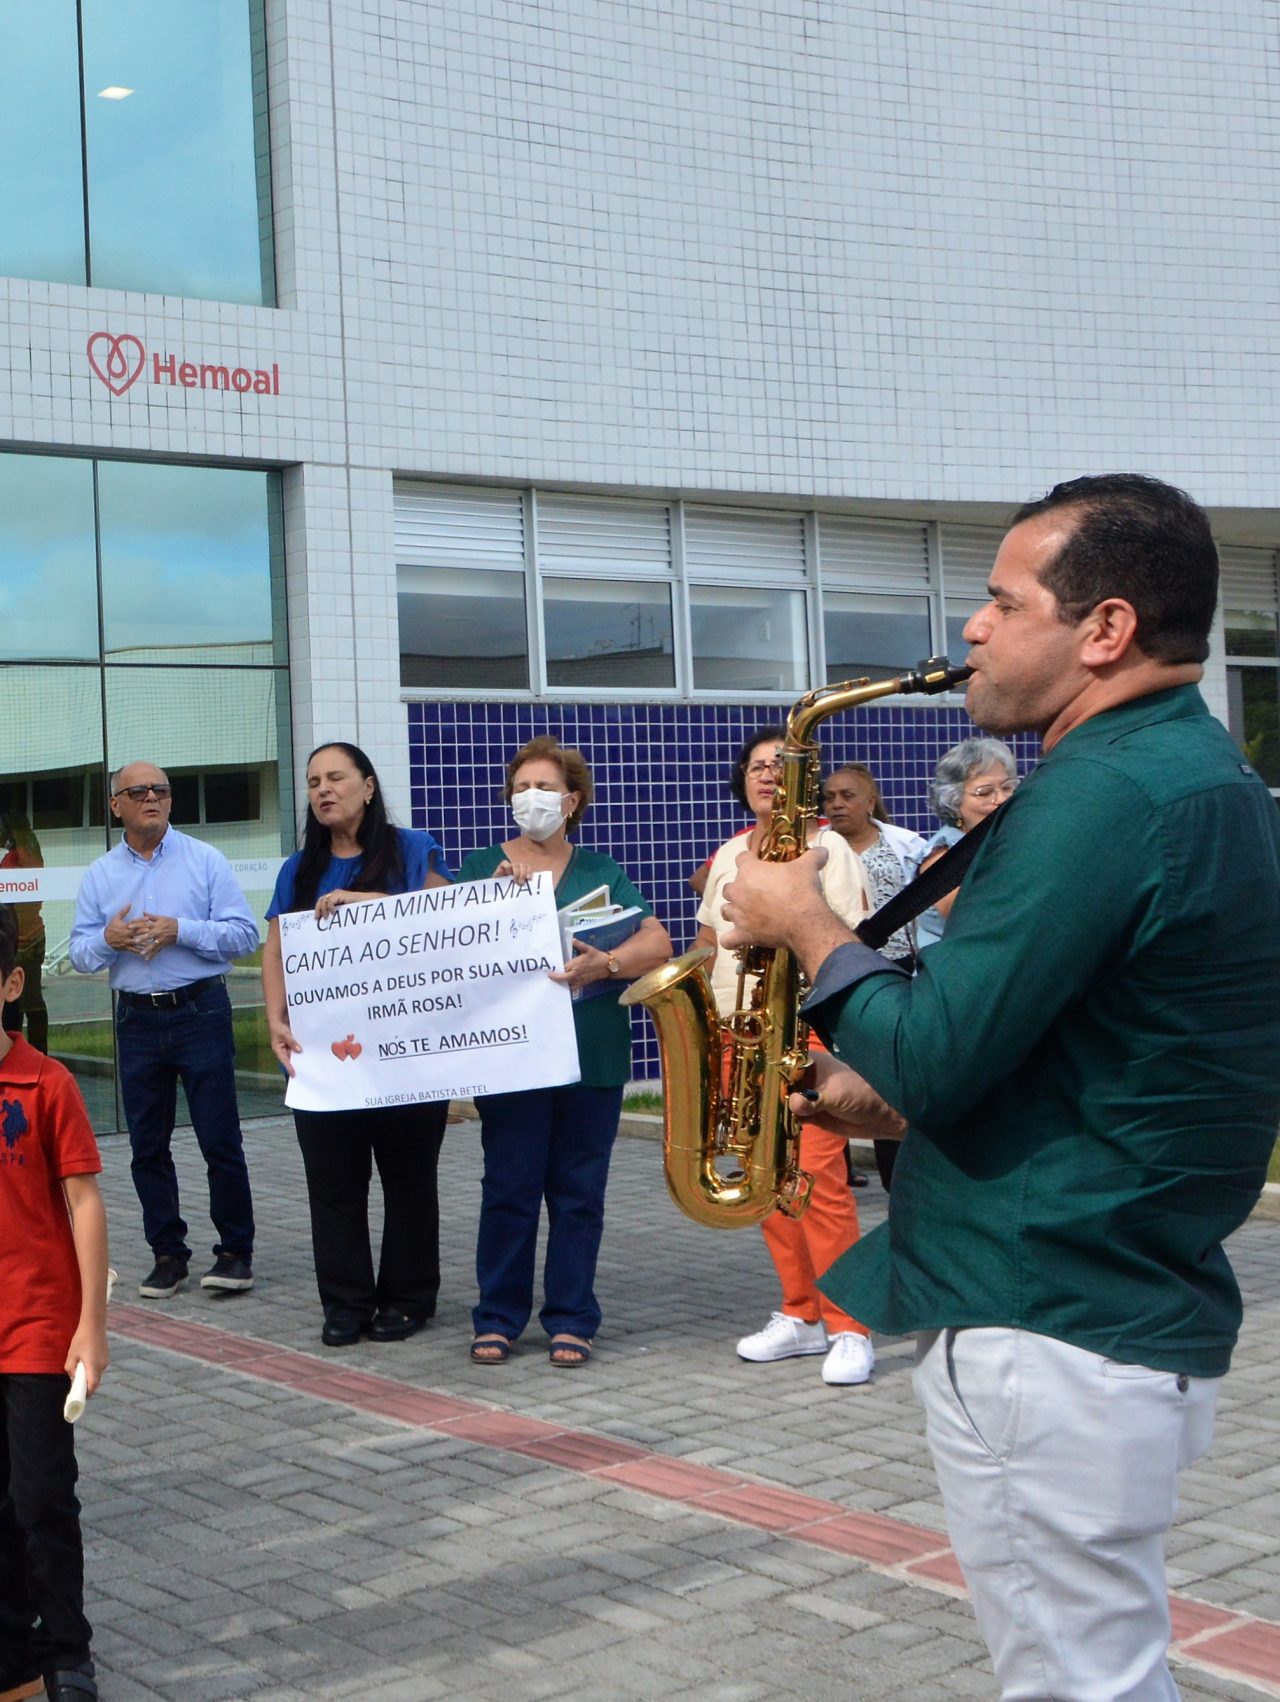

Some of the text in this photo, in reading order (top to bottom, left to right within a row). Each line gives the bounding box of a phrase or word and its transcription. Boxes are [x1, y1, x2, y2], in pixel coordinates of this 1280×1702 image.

[152, 352, 280, 396] Hemoal
[316, 901, 387, 932] CANTA
[284, 919, 500, 975] CANTA AO SENHOR!
[287, 956, 557, 1007] LOUVAMOS A DEUS POR SUA VIDA,
[367, 993, 464, 1021] IRMÃ ROSA!
[378, 1024, 529, 1058] NÓS TE AMAMOS!
[364, 1084, 489, 1107] SUA IGREJA BATISTA BETEL
